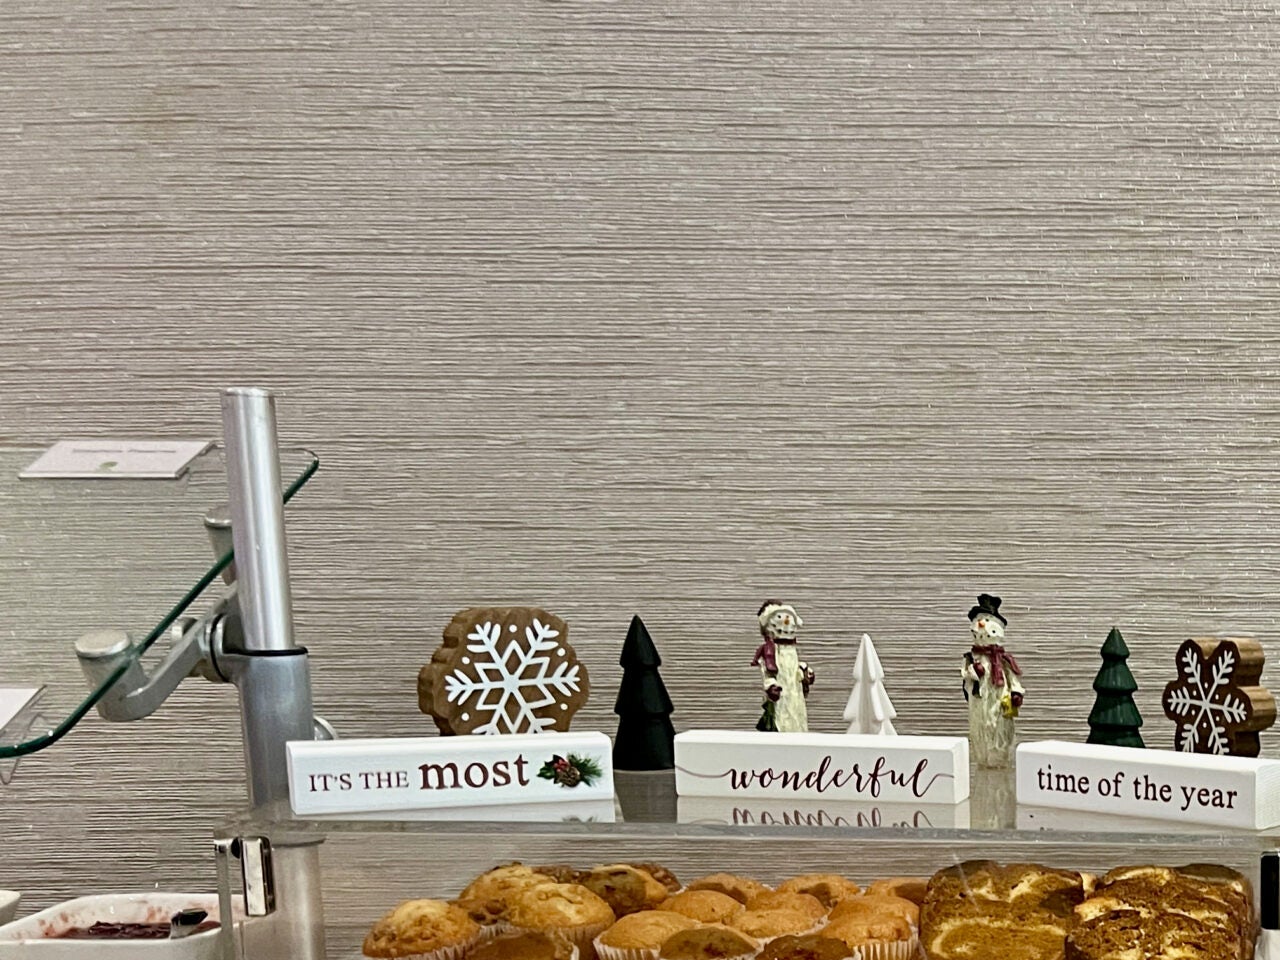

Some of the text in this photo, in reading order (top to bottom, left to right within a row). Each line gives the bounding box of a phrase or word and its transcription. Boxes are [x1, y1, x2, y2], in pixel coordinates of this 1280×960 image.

[309, 753, 530, 792] IT'S THE most
[712, 755, 945, 798] wonderful
[1037, 764, 1238, 811] time of the year
